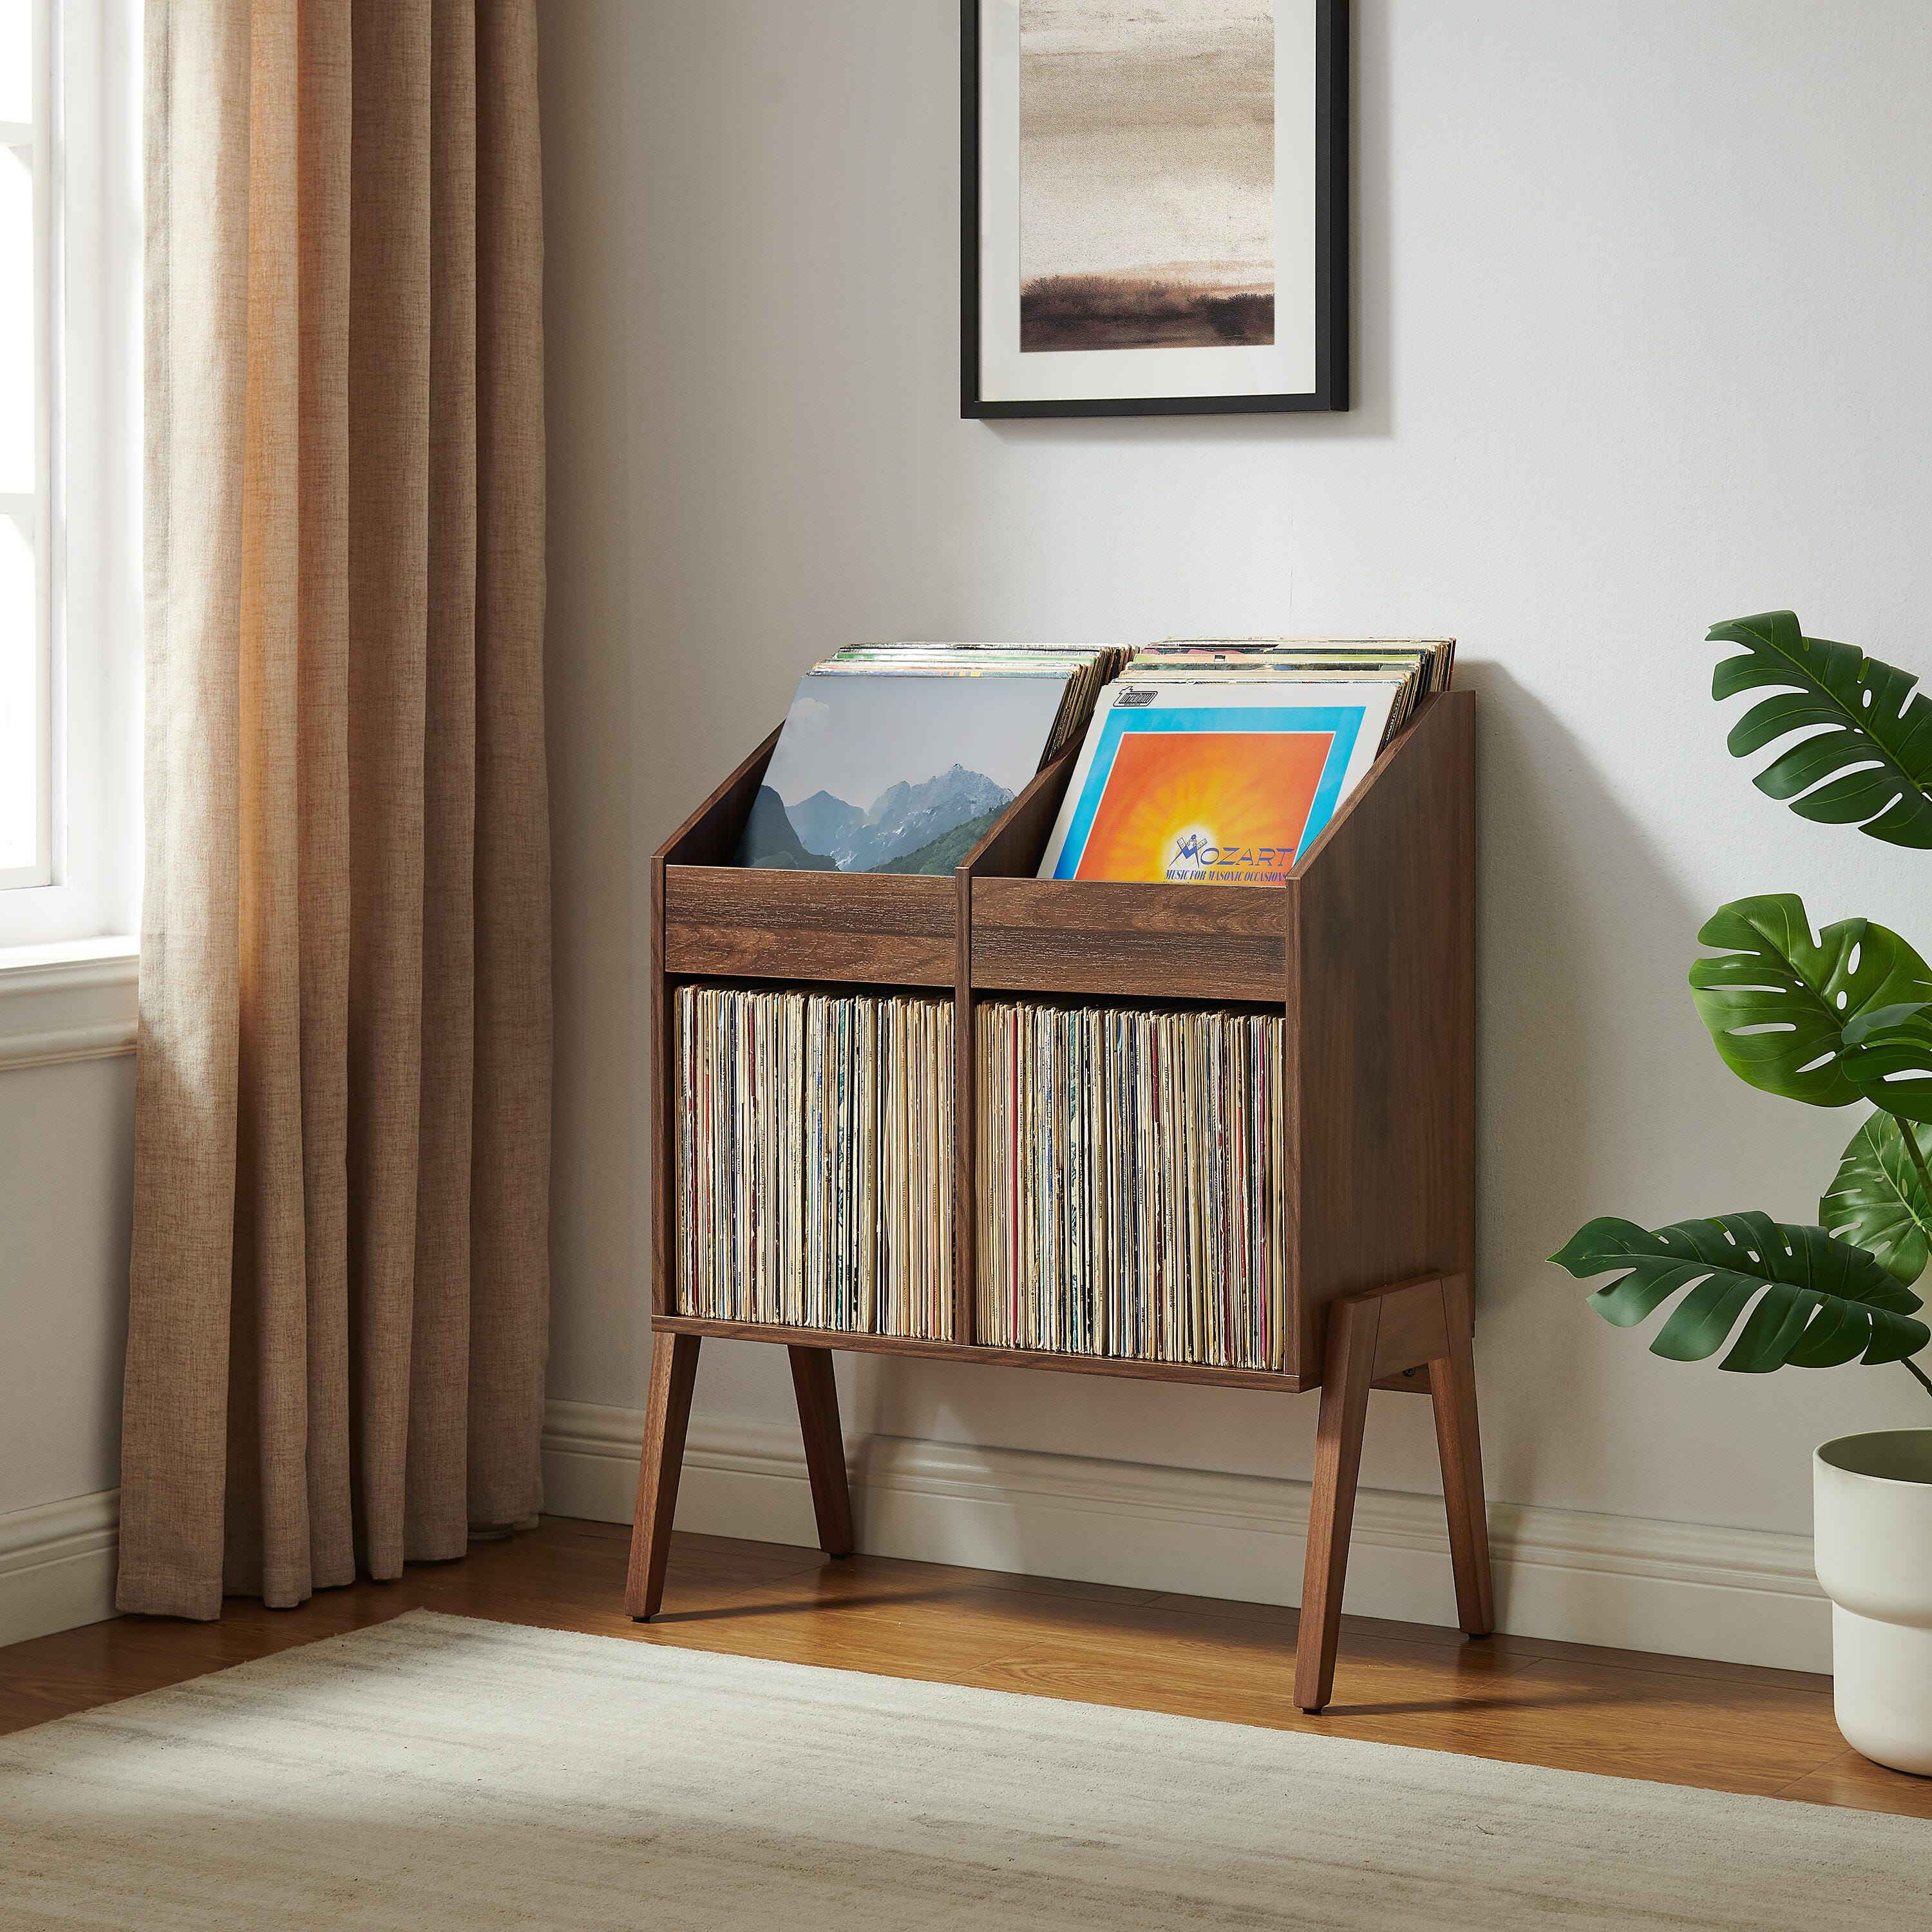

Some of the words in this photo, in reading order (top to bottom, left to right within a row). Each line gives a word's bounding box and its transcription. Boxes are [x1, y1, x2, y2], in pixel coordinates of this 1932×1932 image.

[1168, 840, 1295, 869] MOZART
[1164, 869, 1189, 880] MUSIC
[1189, 870, 1206, 881] FOR
[1208, 871, 1244, 882] MASONIC
[1244, 871, 1287, 882] OCCASIONS
